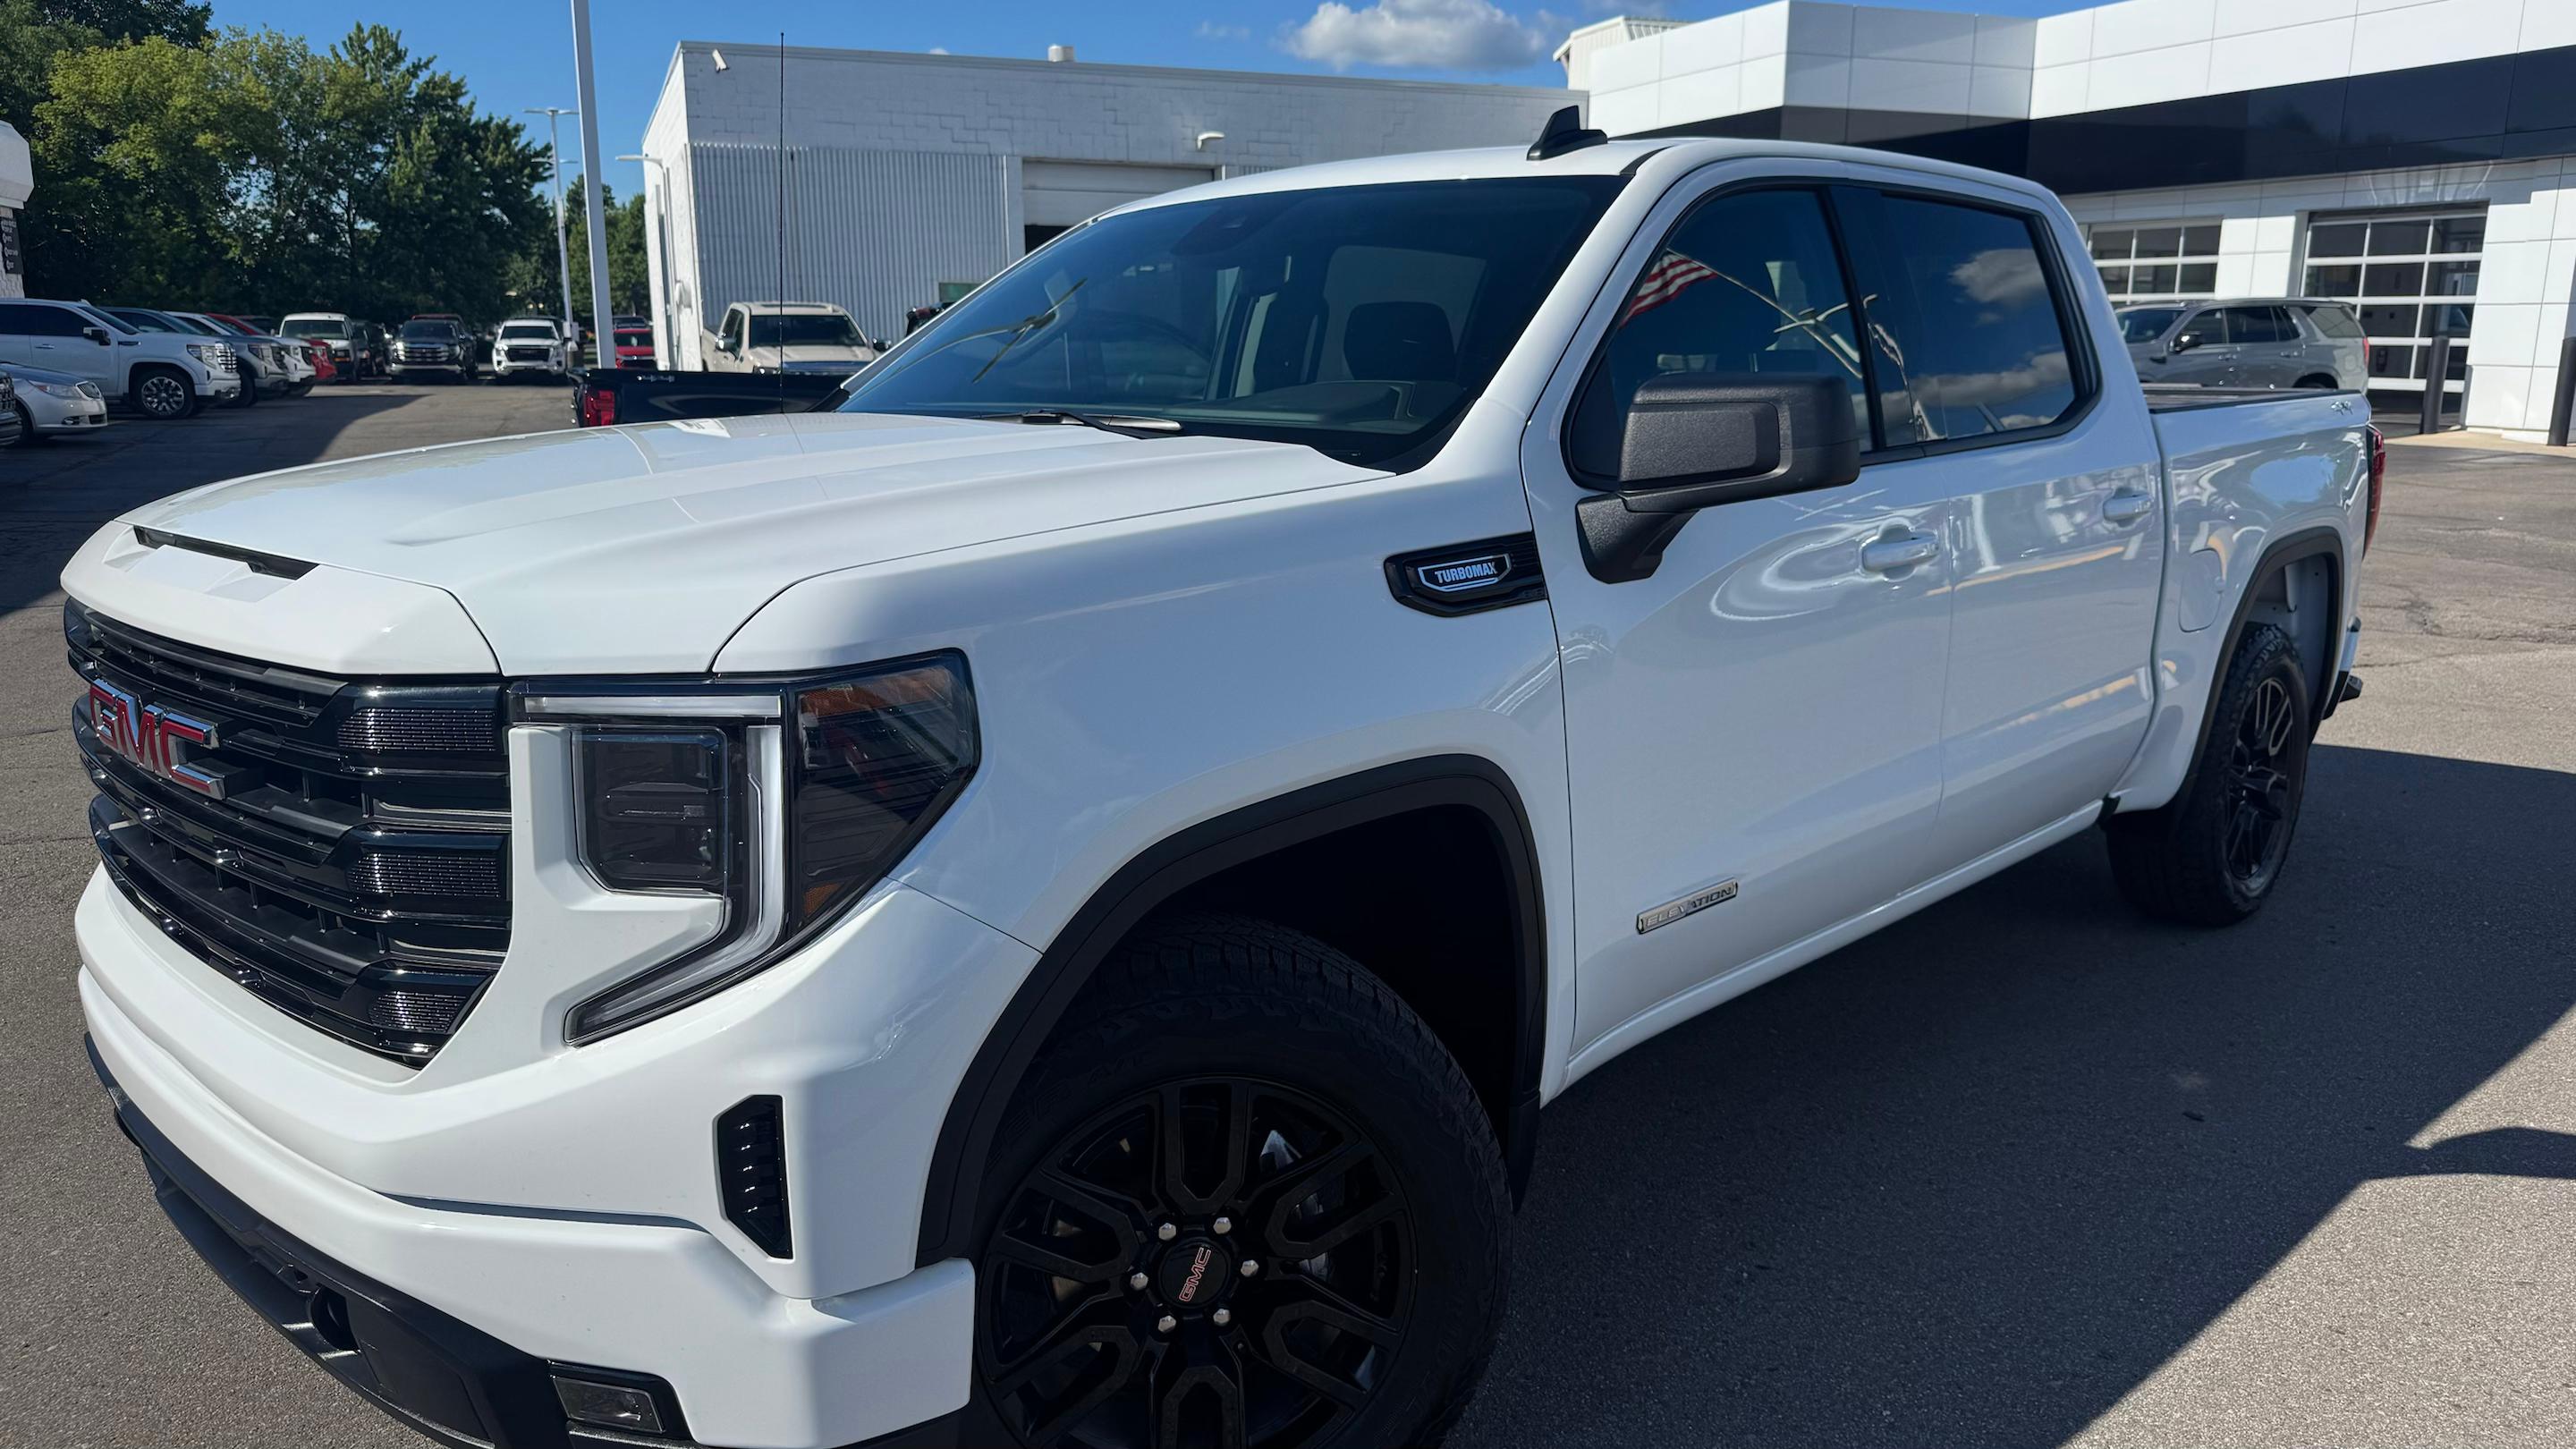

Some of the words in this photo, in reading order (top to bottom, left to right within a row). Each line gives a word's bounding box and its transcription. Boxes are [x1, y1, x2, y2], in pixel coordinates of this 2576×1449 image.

[1435, 561, 1498, 584] TURBOMAX
[90, 678, 225, 801] GMC
[1179, 1247, 1212, 1302] GMC
